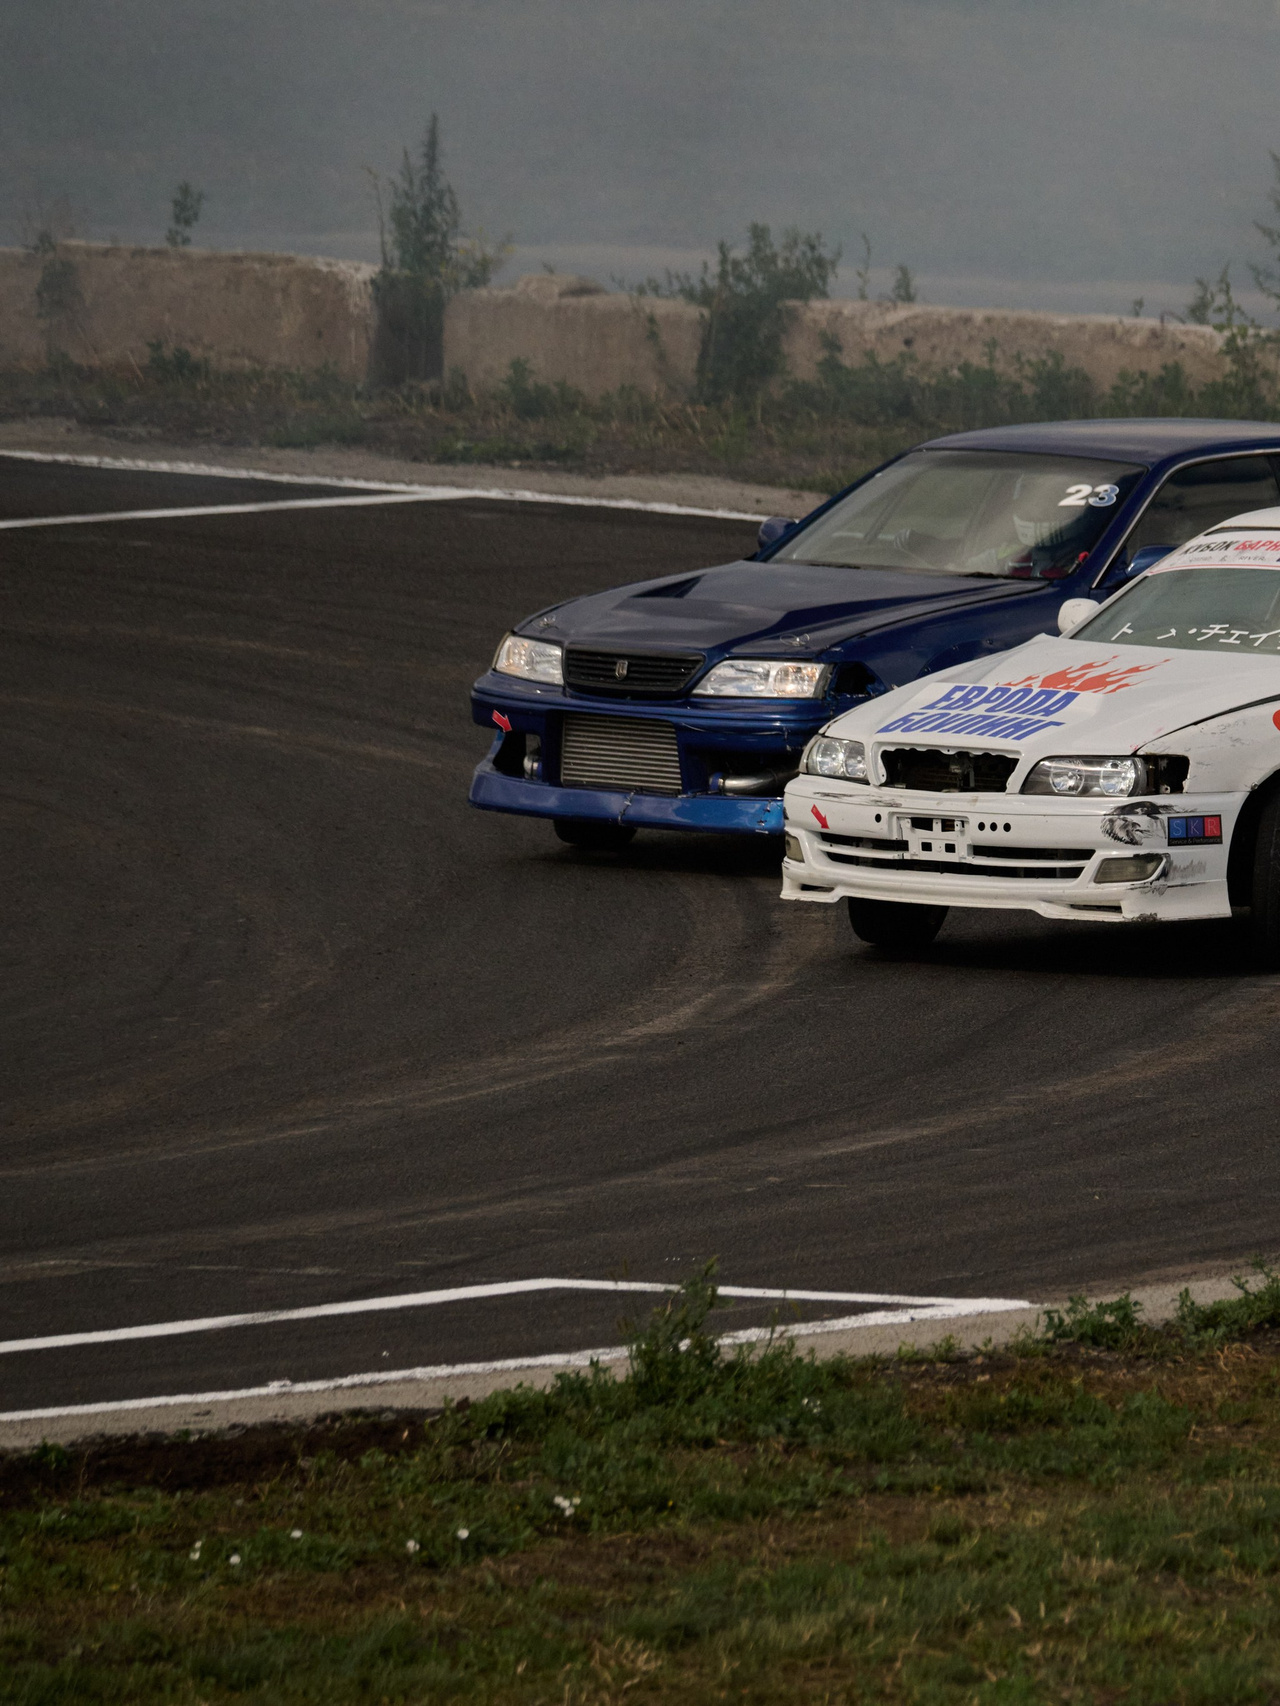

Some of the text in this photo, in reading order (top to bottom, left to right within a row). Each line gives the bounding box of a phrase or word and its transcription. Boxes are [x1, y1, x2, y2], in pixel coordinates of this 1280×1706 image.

[1057, 483, 1120, 507] 23
[1182, 541, 1237, 555] КУБОК
[919, 685, 1081, 717] ЕВРОПА
[875, 711, 1068, 741] БОУЛИНГ
[1172, 819, 1218, 836] SKR
